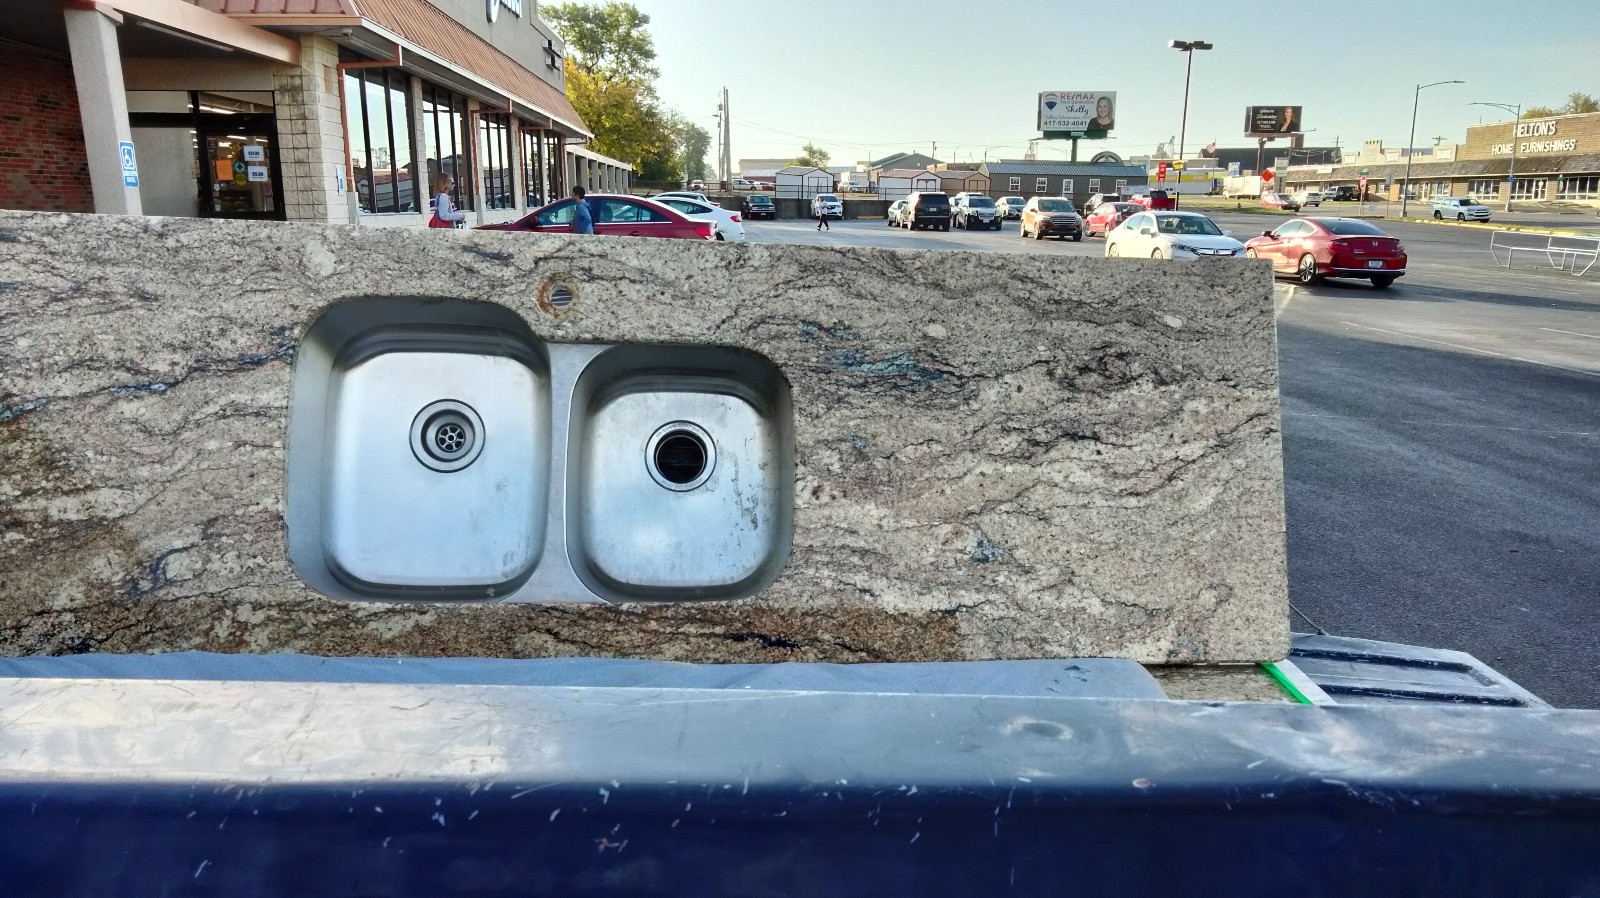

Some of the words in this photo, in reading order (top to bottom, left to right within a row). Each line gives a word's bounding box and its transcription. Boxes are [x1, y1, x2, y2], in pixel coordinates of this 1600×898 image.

[1060, 92, 1095, 100] RE/MAX
[1065, 104, 1089, 116] Shelly
[1491, 143, 1515, 155] HOME
[1520, 138, 1577, 153] FURNISHINGS
